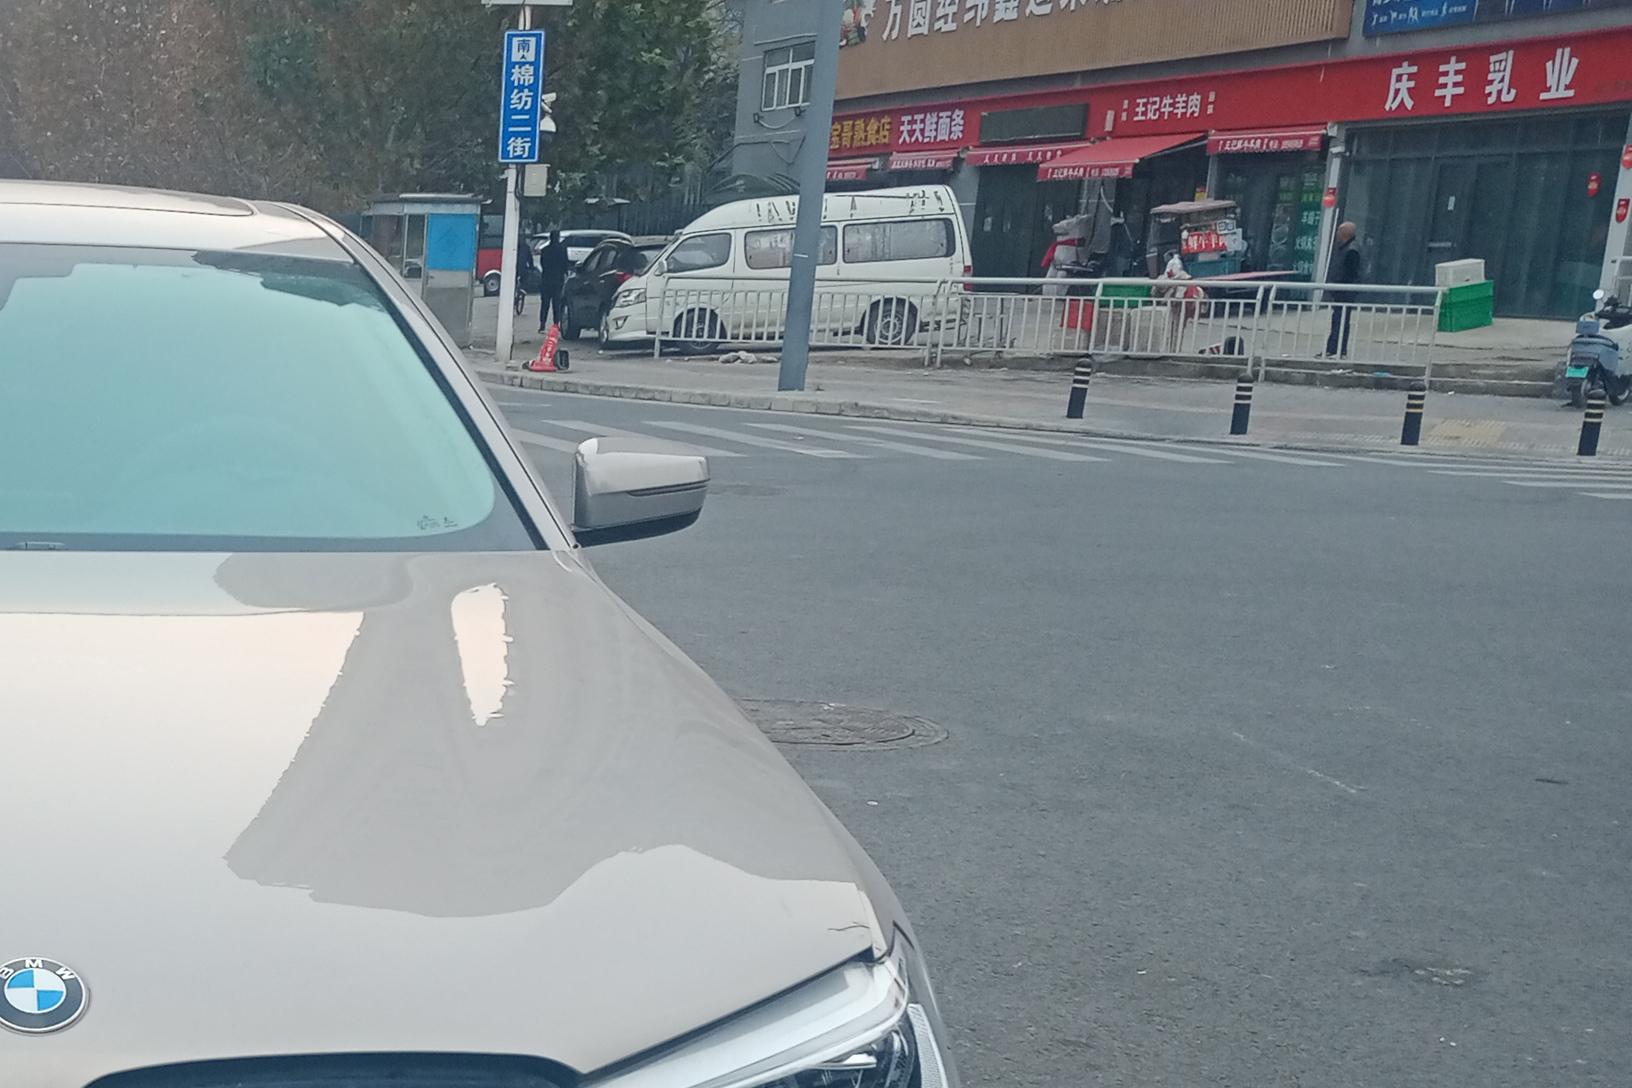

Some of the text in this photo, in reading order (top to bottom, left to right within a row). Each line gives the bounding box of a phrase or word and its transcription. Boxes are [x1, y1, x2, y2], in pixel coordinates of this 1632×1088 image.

[516, 39, 530, 53] 南
[1384, 47, 1579, 111] 庆丰乳业
[507, 64, 534, 158] 棉纺二街
[1133, 92, 1201, 121] 王记牛羊肉
[898, 109, 964, 145] 天天鲜面条
